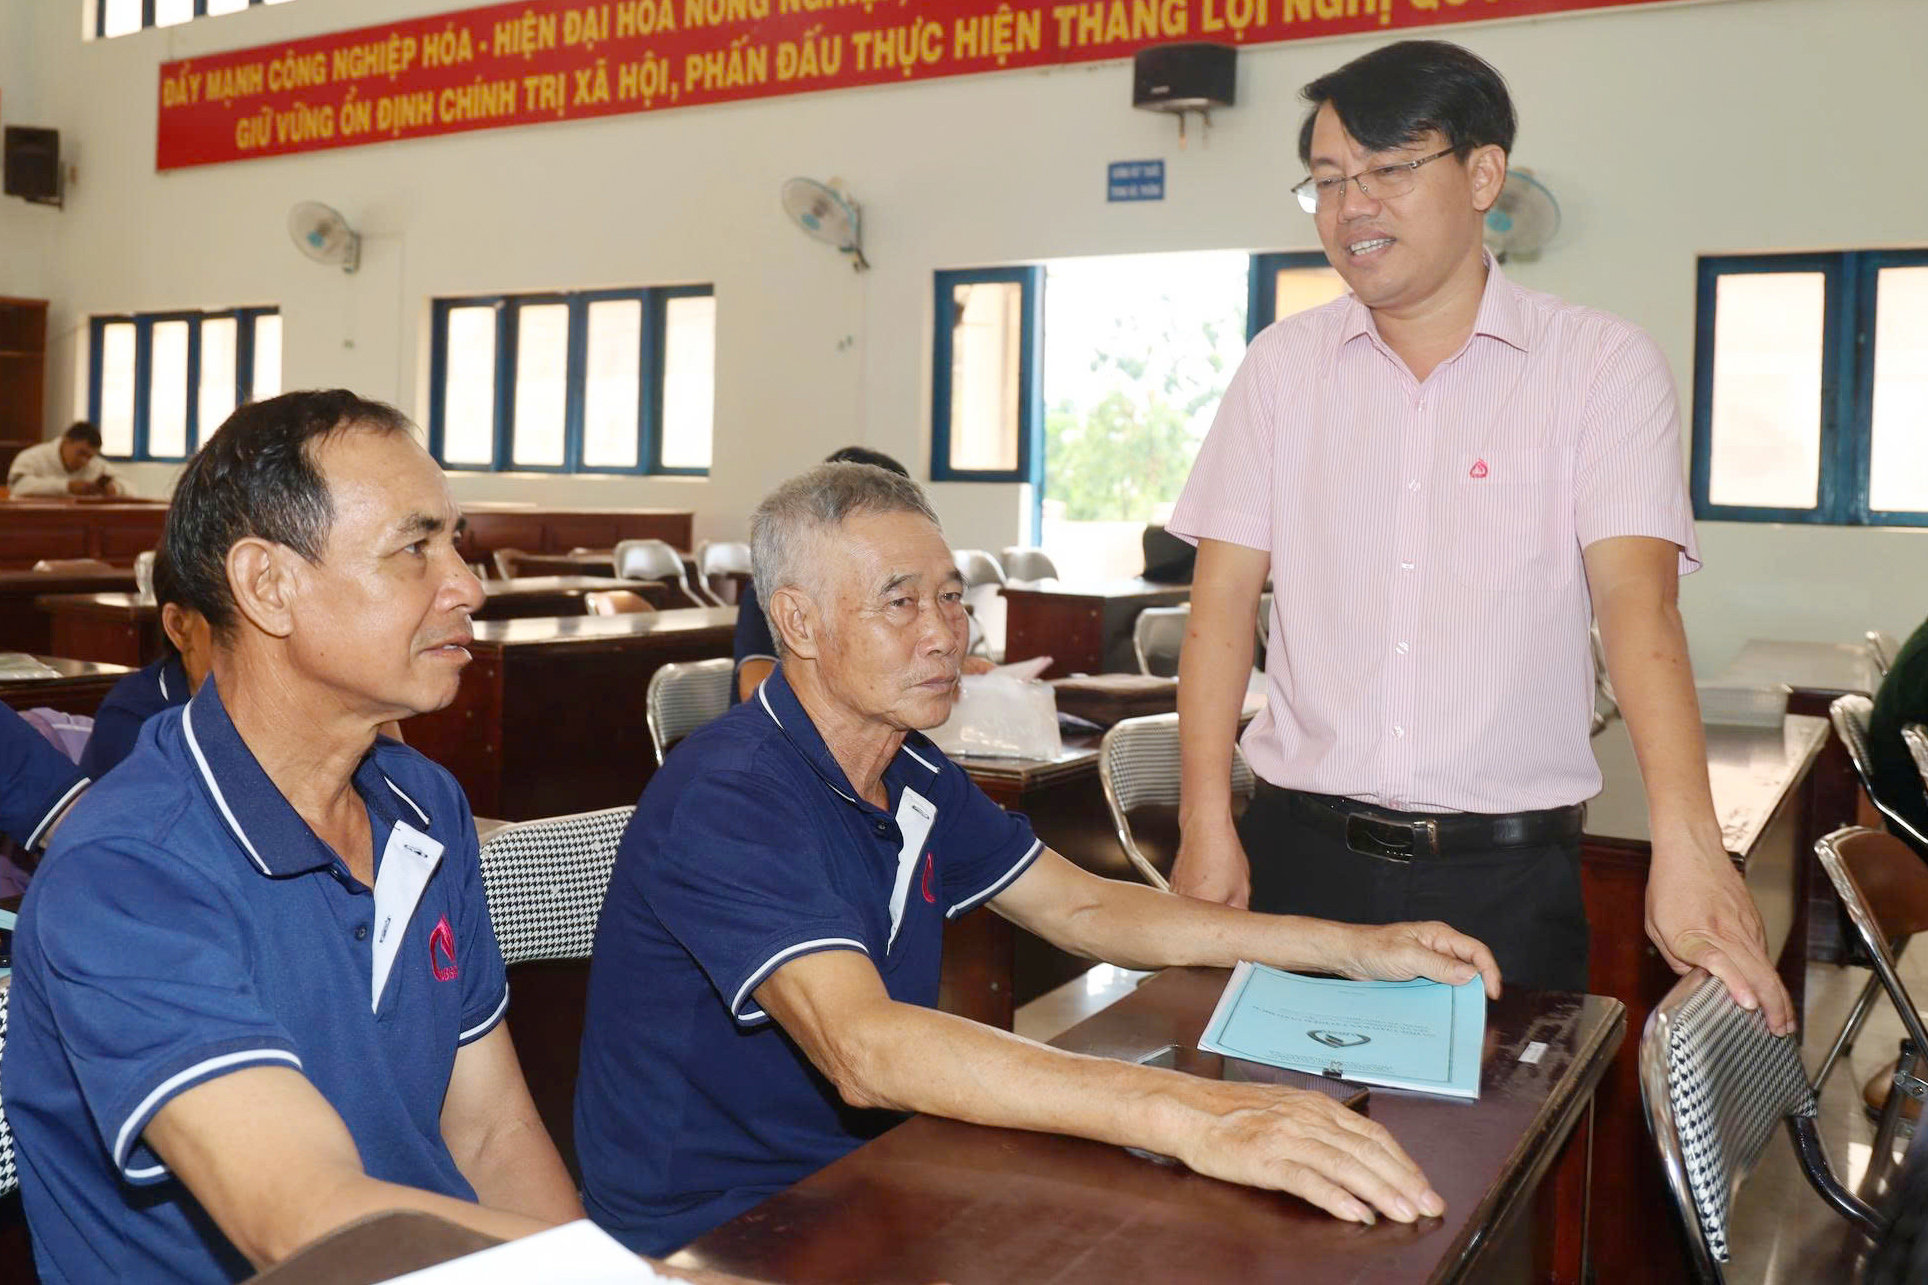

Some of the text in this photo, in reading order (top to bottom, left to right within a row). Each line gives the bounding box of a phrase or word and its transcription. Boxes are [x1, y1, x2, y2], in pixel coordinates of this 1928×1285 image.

[205, 64, 264, 106] MẠNH
[268, 49, 327, 92] CÔNG
[332, 33, 417, 81] NGHIỆP
[421, 22, 474, 67] HÓA
[493, 9, 558, 61] HIỆN
[561, 3, 611, 51] ĐẠI
[376, 91, 435, 137] ĐỊNH
[438, 76, 518, 123] CHÍNH
[522, 72, 567, 118] TRỊ
[572, 58, 611, 107] XÃ
[617, 50, 680, 109] HỘI,
[684, 35, 769, 93] PHẤN
[777, 24, 843, 82] ĐẤU
[850, 16, 944, 78] THỰC
[953, 4, 1042, 66] HIỆN
